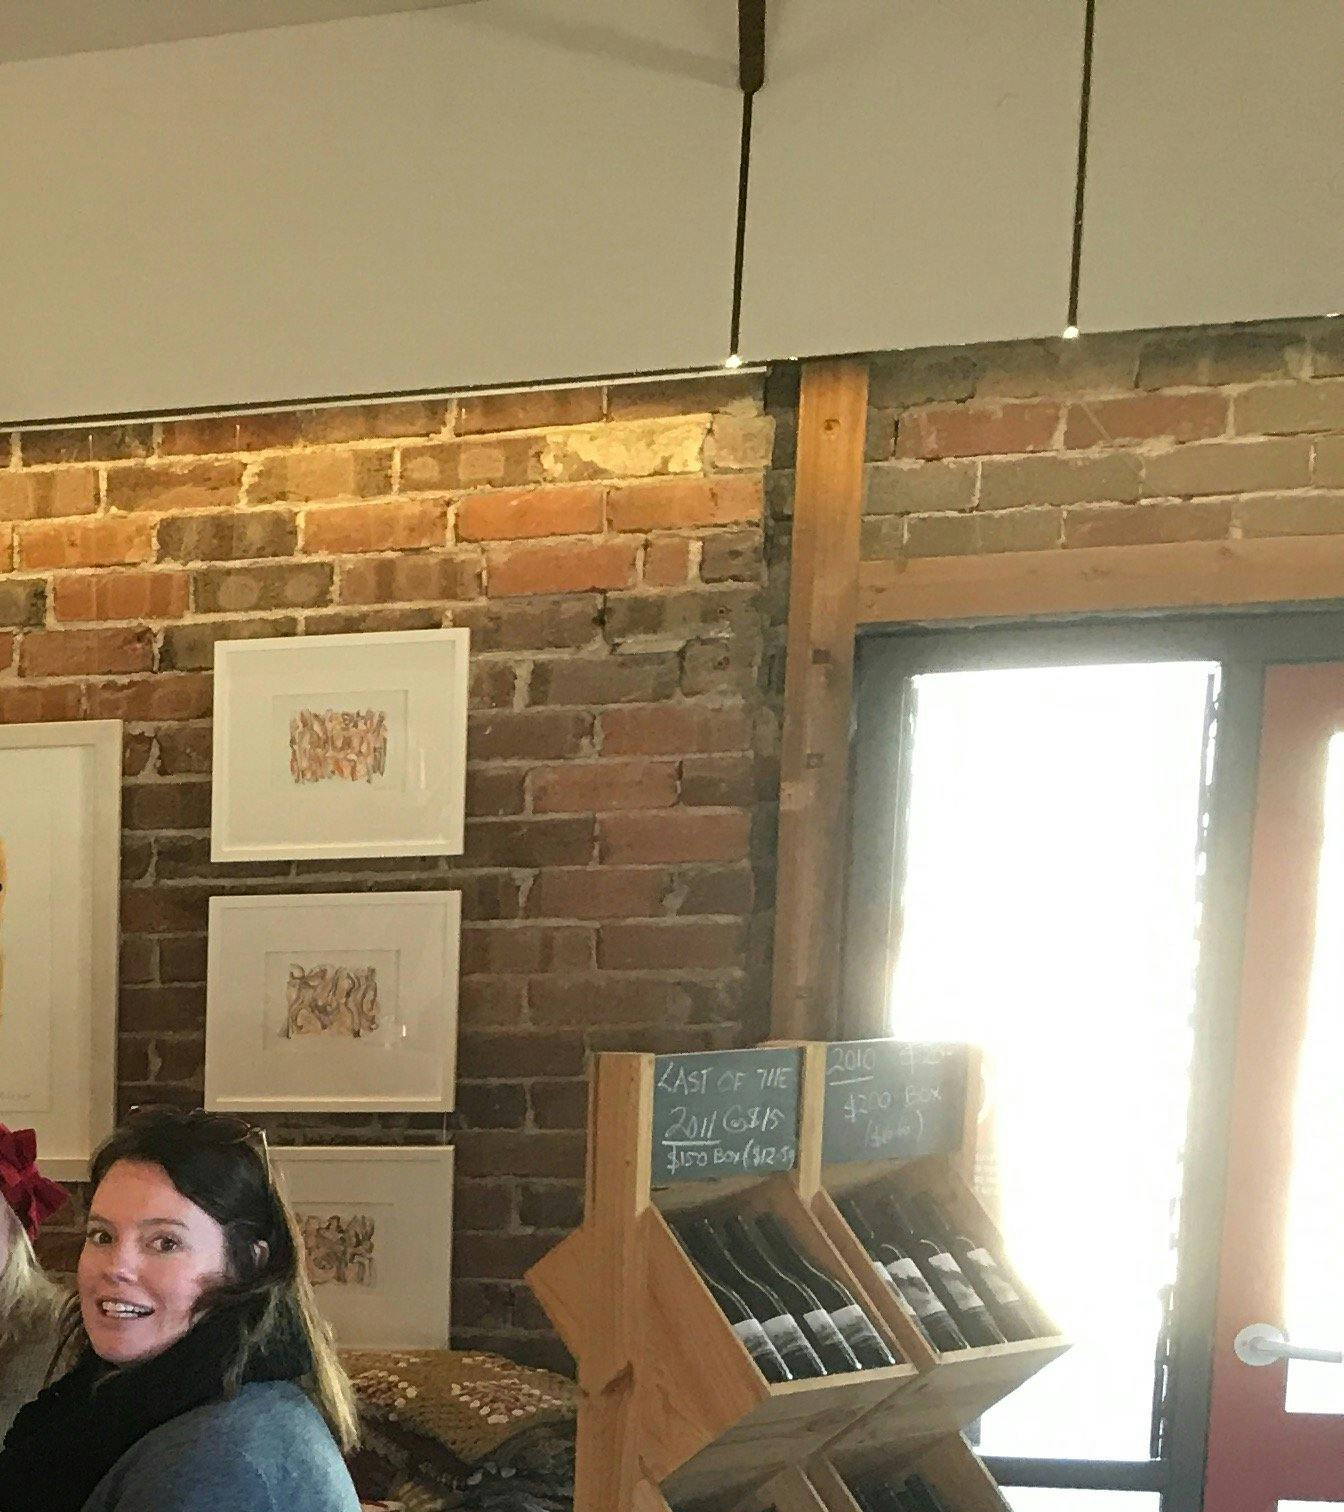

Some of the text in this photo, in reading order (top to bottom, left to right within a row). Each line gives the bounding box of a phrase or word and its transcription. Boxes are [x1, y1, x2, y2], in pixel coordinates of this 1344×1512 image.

[826, 1048, 875, 1075] 2010
[658, 1062, 792, 1095] LAST OF THE
[665, 1106, 717, 1139] 2011
